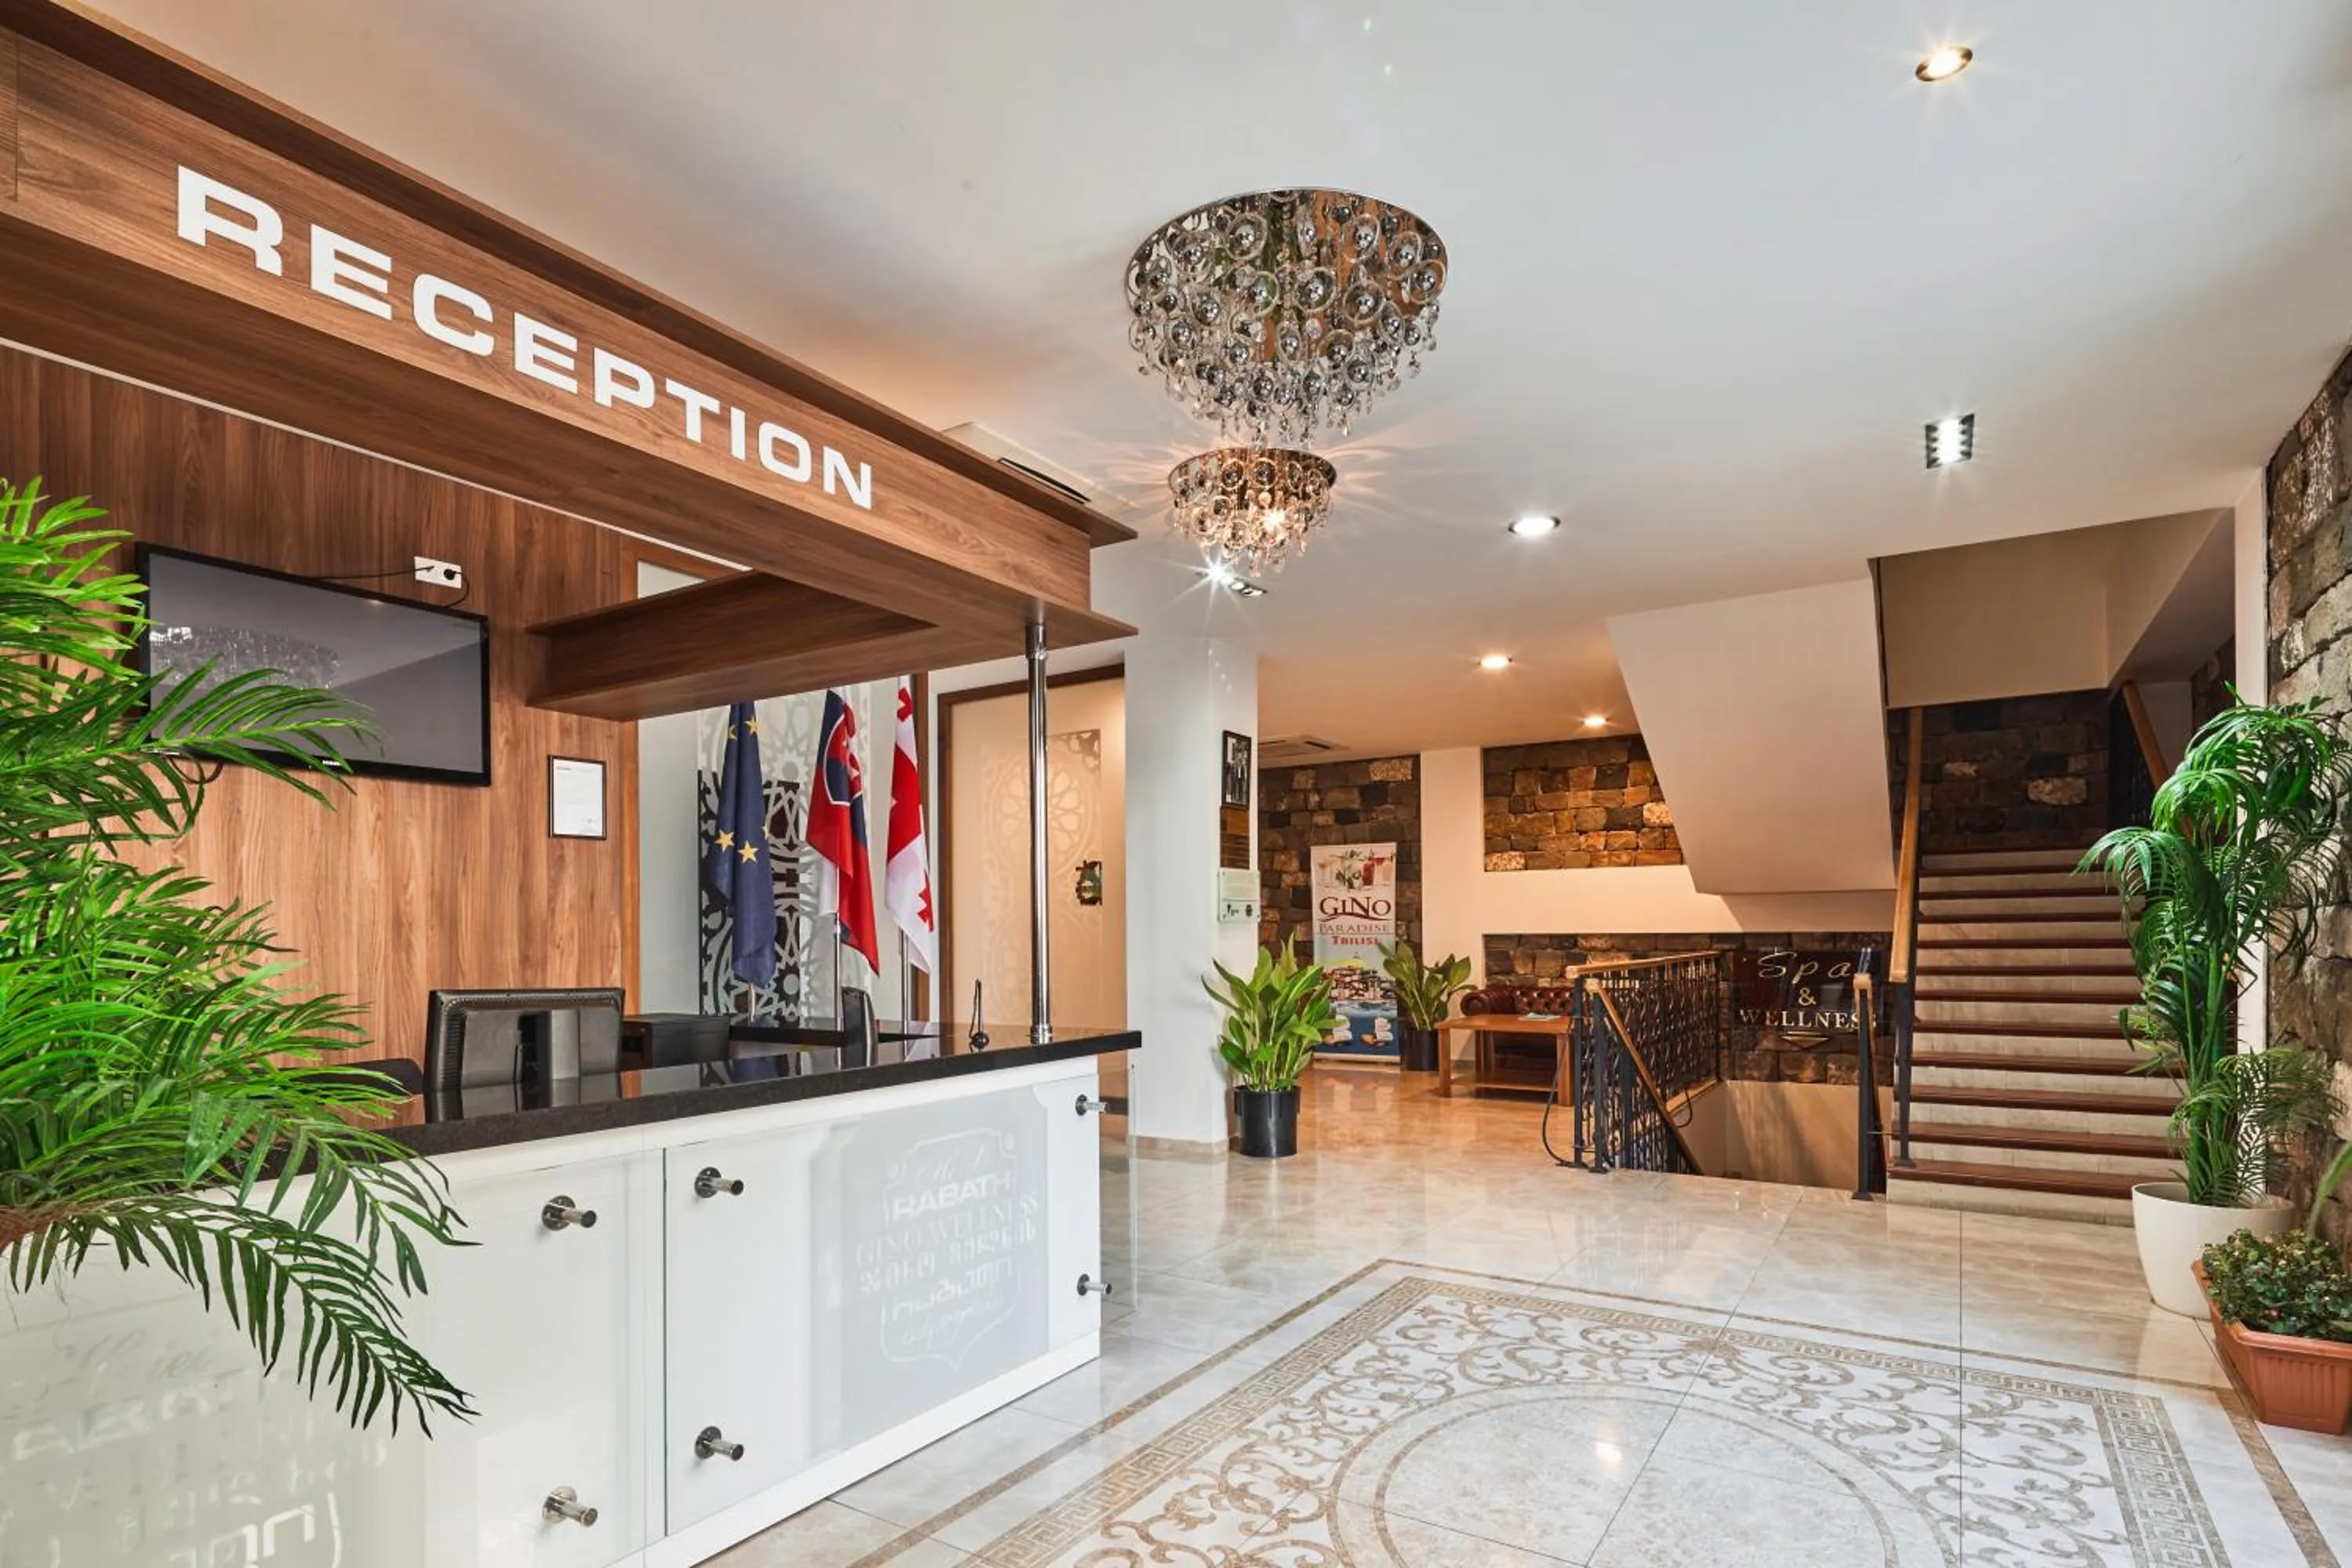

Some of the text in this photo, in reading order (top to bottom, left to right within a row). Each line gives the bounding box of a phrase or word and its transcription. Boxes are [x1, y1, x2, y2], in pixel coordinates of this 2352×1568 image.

[177, 164, 873, 510] RECEPTION
[1319, 896, 1392, 916] GINO
[1319, 924, 1388, 934] PARADISE
[1757, 947, 1852, 984] Spa
[1798, 987, 1817, 1006] &
[1740, 1008, 1877, 1030] WELLNES
